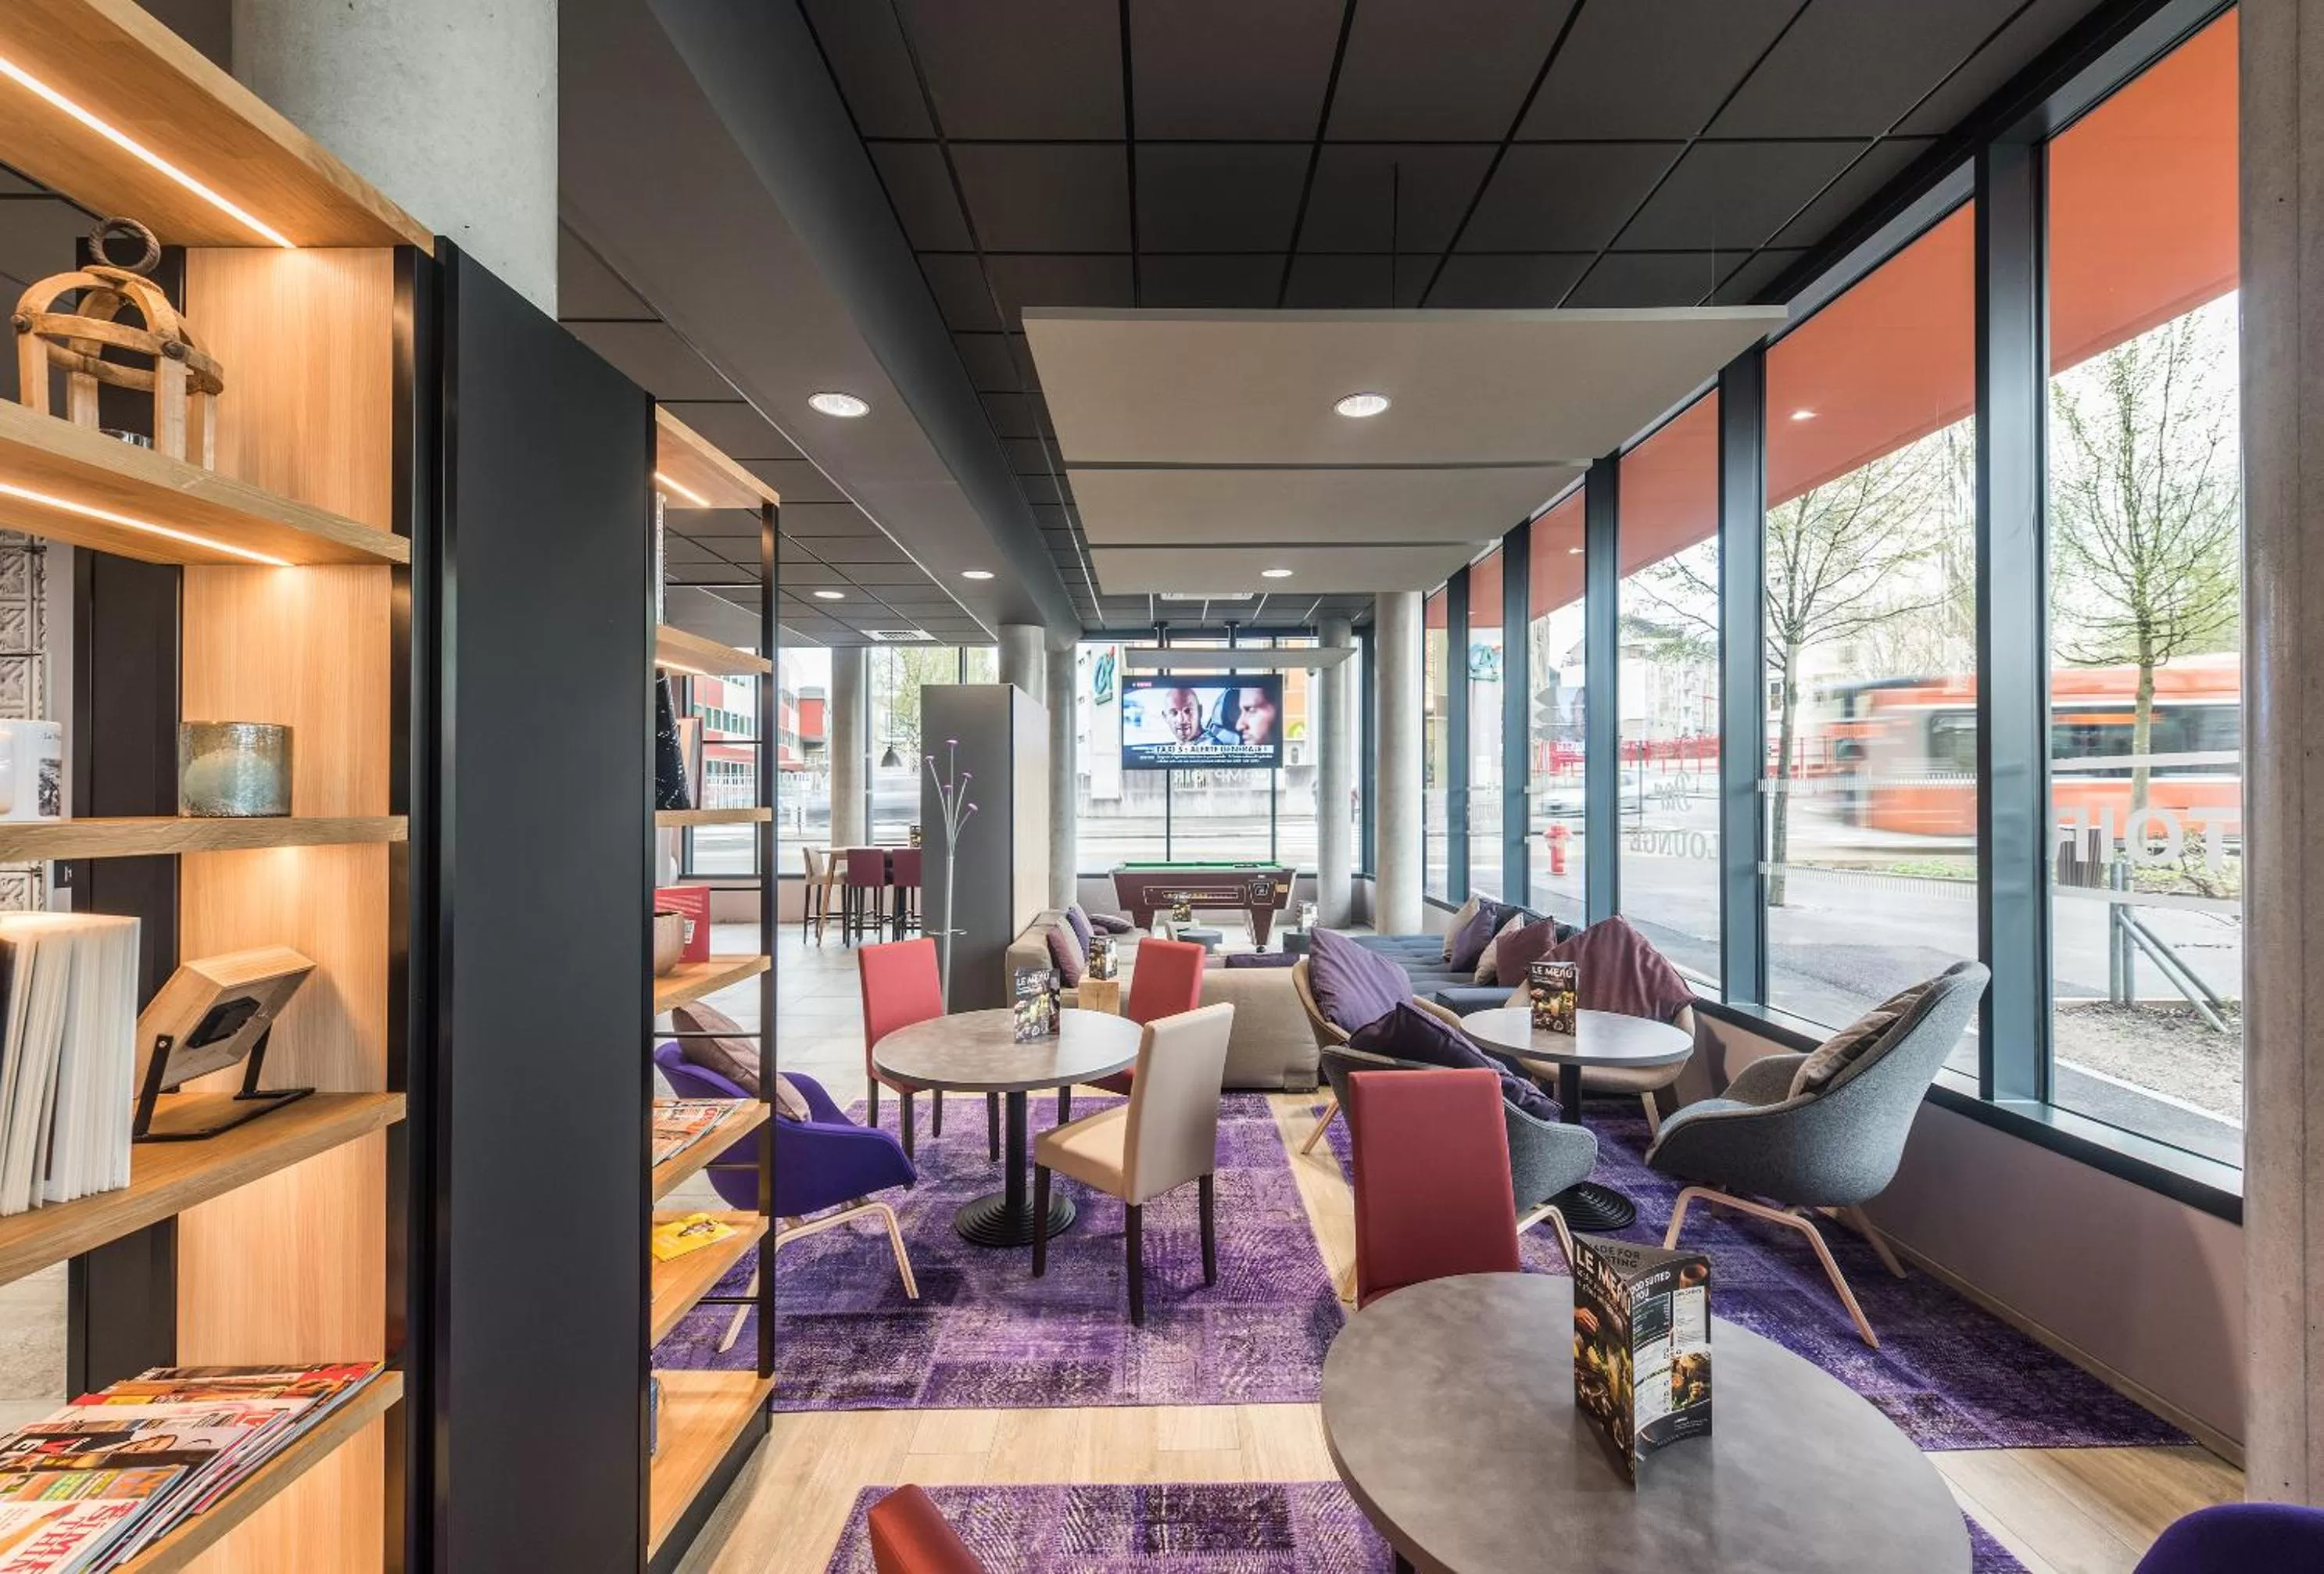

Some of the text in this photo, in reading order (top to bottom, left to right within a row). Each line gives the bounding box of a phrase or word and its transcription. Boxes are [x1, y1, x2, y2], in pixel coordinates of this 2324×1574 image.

[1532, 966, 1574, 978] LE MENU
[1016, 976, 1026, 986] LE
[1577, 1243, 1595, 1274] LE
